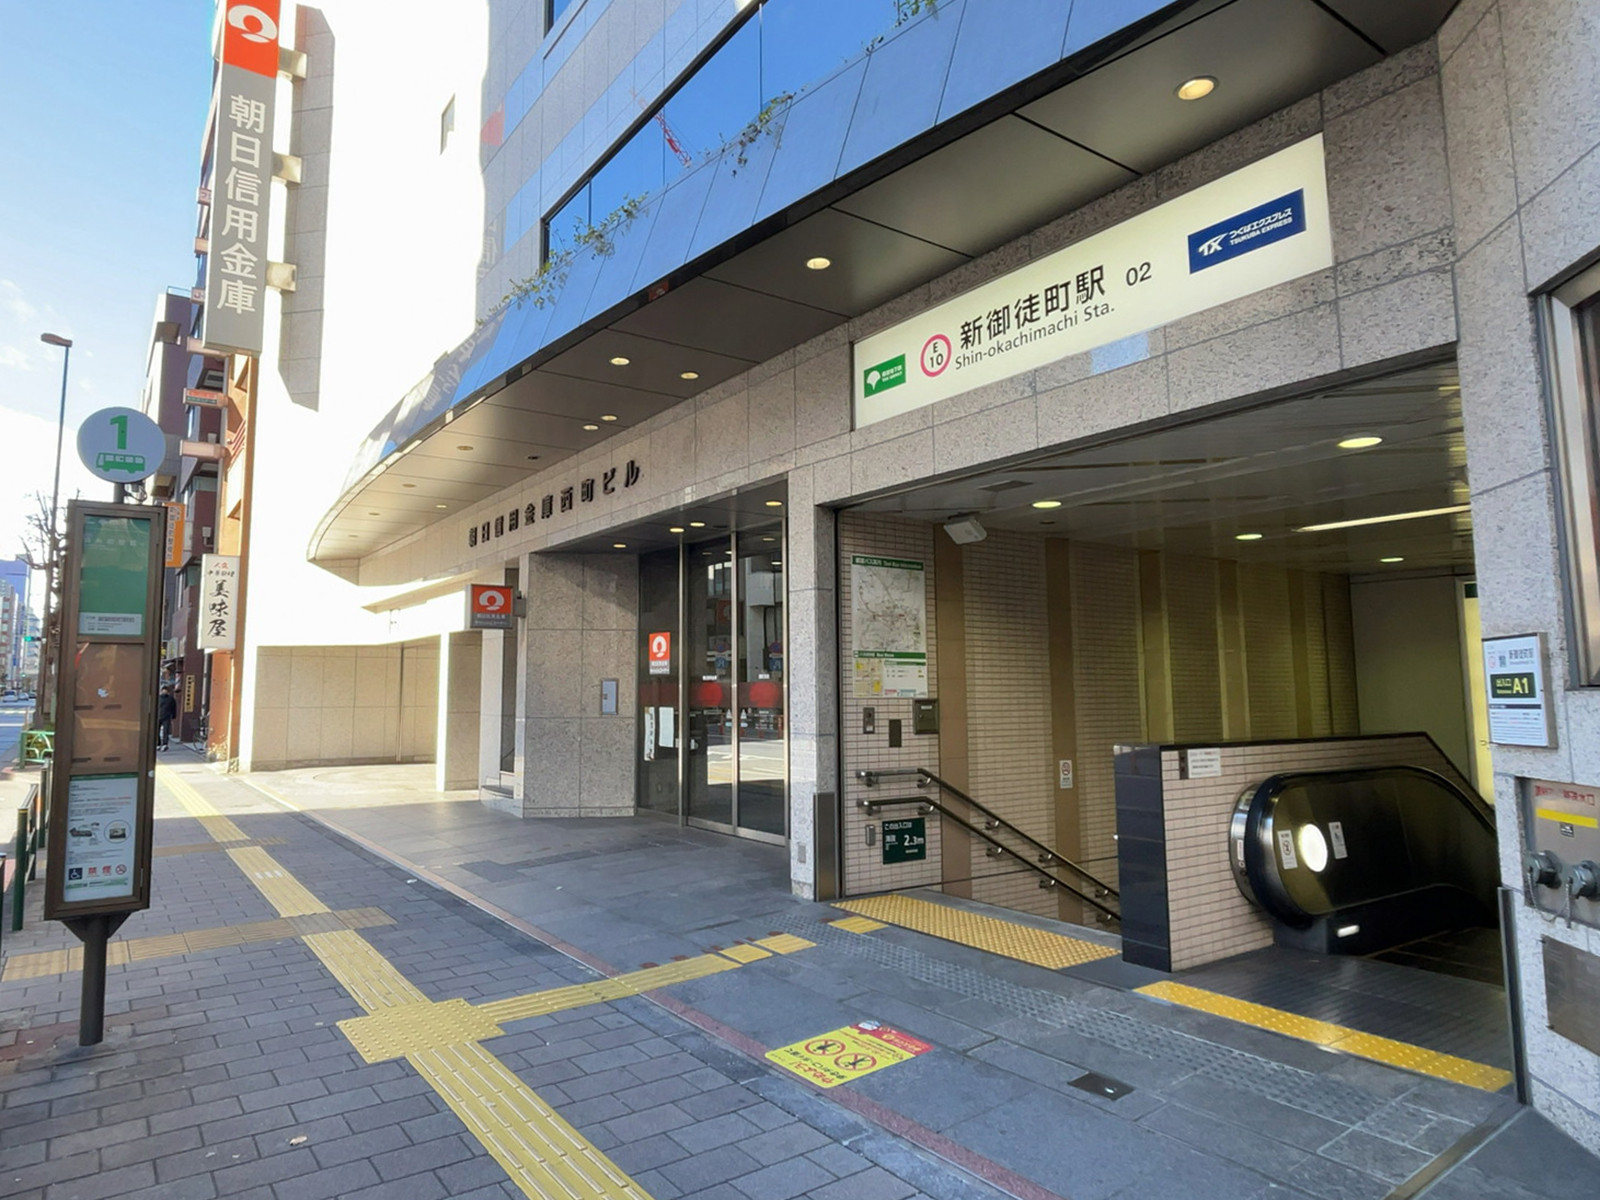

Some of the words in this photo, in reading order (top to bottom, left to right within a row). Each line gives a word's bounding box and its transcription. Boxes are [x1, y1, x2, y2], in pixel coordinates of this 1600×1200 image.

[216, 94, 266, 315] 朝日信用金庫
[1229, 207, 1293, 239] つくばエクスプレス
[1229, 230, 1261, 246] TSUKUBA
[1261, 217, 1293, 234] EXPRESS
[1126, 262, 1152, 287] 02
[960, 265, 1106, 350] 新御徒町駅
[932, 341, 939, 354] E
[955, 311, 1079, 370] Shin-okachimachi
[1083, 302, 1115, 322] Sta.
[929, 353, 944, 368] 10
[110, 415, 128, 450] 1
[207, 579, 230, 639] 美味屋
[1512, 677, 1530, 694] A1
